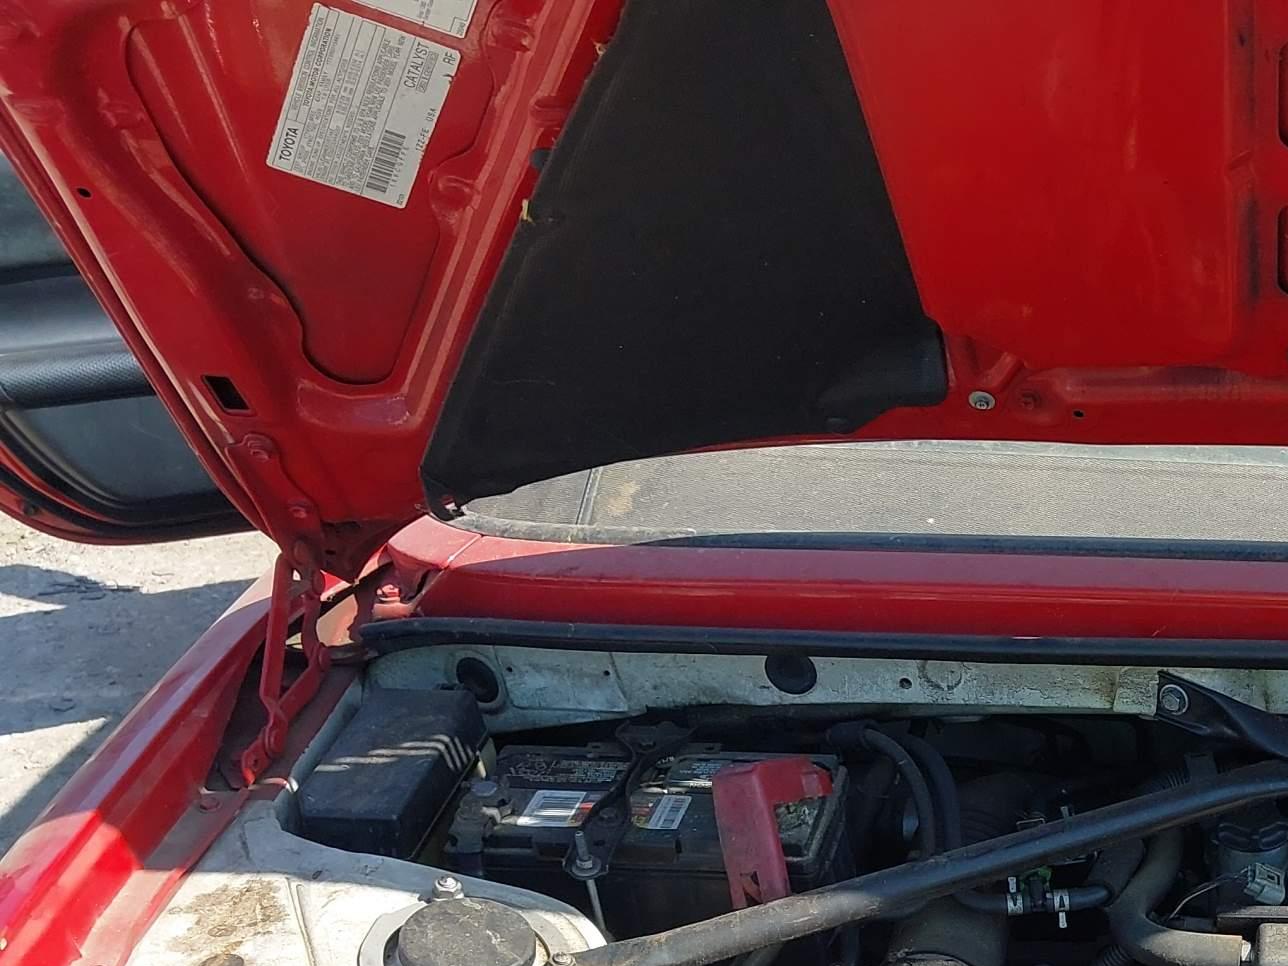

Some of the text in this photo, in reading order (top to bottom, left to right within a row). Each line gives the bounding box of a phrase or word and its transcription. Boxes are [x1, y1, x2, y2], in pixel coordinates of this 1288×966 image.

[315, 28, 332, 66] CORPORATION
[404, 42, 429, 88] CATALYST
[443, 52, 456, 66] RF
[279, 127, 299, 162] TOYOTA
